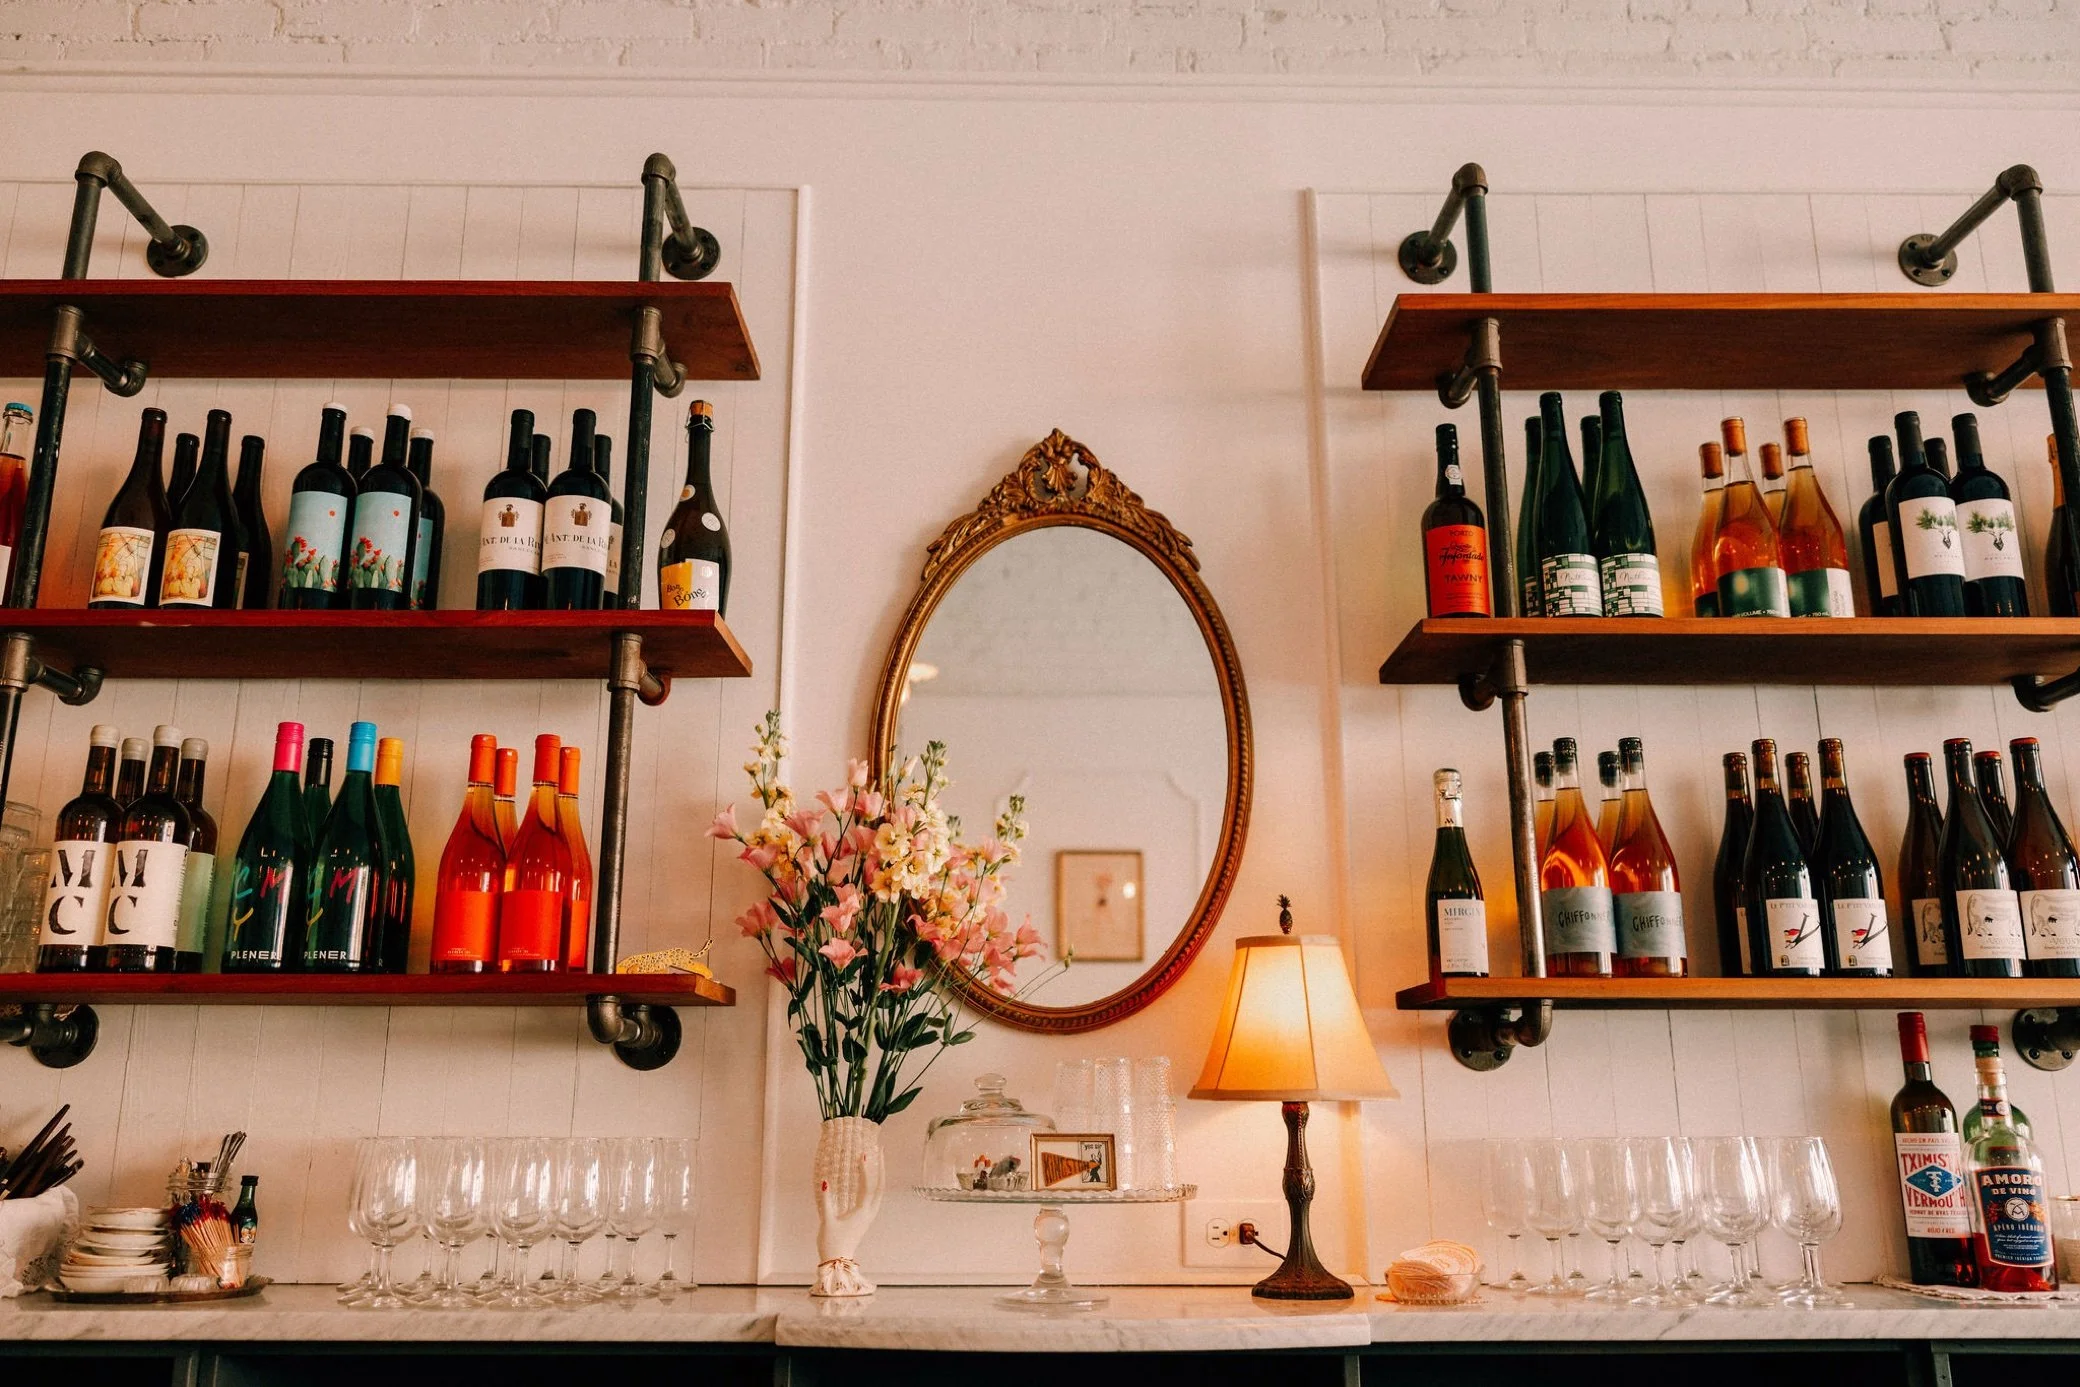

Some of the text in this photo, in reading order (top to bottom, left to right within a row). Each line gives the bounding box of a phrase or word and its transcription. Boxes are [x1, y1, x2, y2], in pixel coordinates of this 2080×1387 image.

[1444, 573, 1483, 583] TAWNY
[231, 950, 278, 960] PLENER
[304, 950, 347, 960] PLENER
[1981, 1173, 2042, 1187] AMORO
